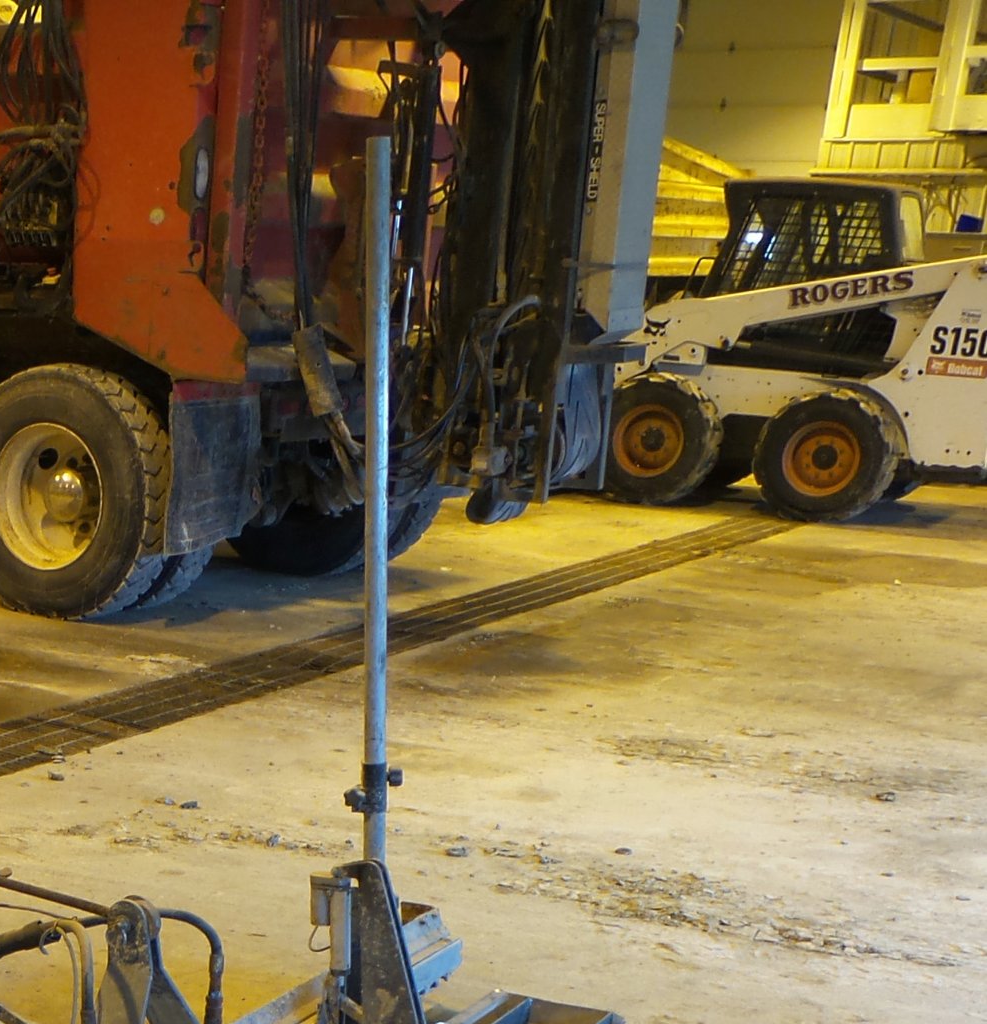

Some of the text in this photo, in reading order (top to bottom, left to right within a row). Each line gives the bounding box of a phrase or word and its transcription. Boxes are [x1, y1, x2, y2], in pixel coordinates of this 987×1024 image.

[593, 102, 607, 142] SUPER
[587, 157, 601, 199] SHIELD
[789, 271, 914, 308] ROGERS
[947, 362, 984, 377] Bobcat
